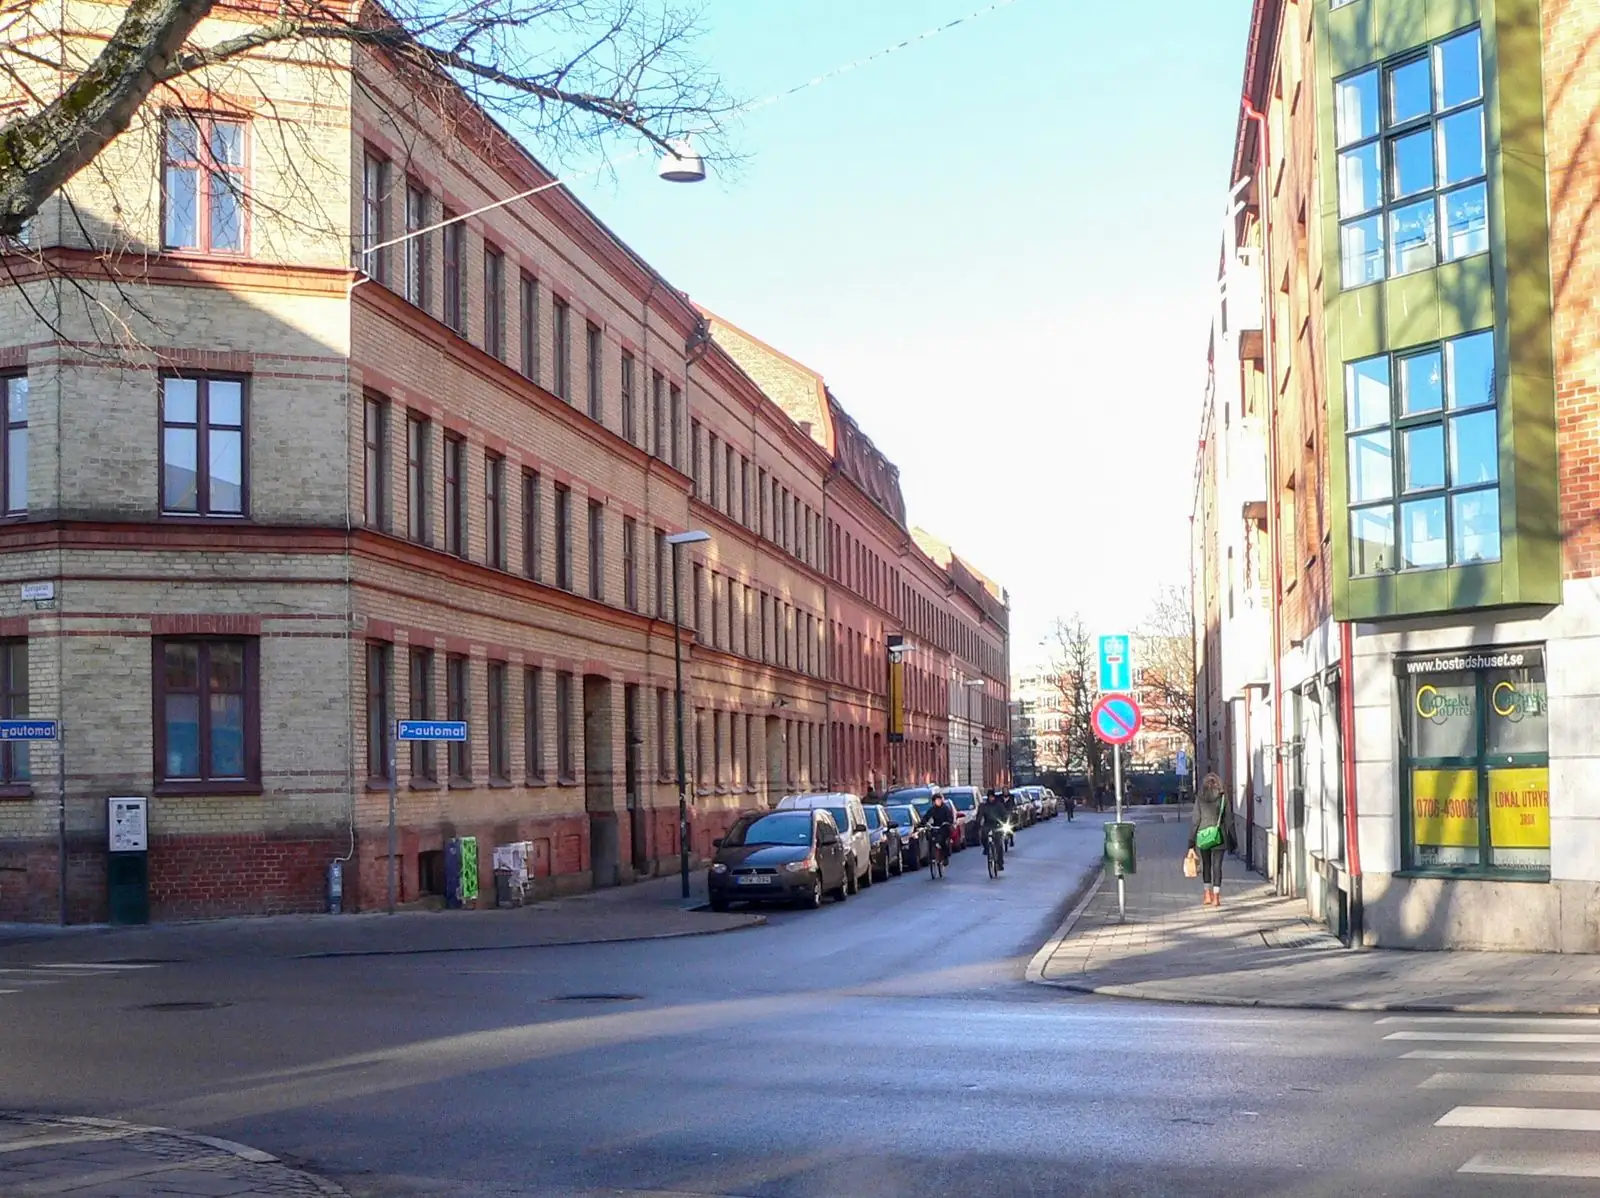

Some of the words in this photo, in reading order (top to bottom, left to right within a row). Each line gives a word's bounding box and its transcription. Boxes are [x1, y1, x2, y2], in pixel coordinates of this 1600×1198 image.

[1406, 653, 1524, 673] www.bostadshuset.se
[0, 725, 55, 736] -automat
[400, 725, 465, 736] P-automat
[1495, 791, 1521, 808] LOKAL
